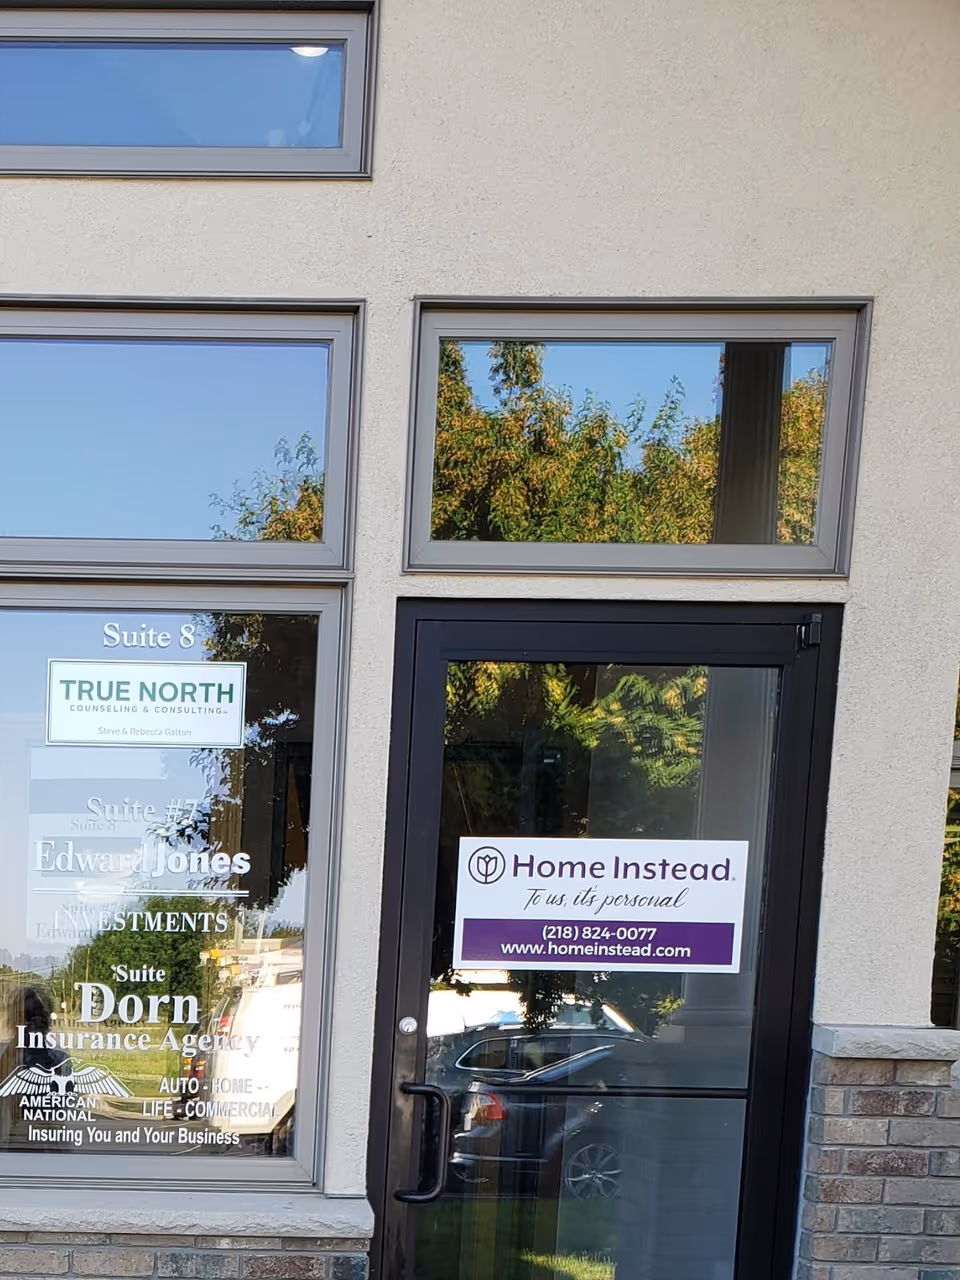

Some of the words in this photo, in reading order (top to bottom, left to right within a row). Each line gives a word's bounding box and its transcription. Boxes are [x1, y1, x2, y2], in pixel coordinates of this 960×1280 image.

[103, 622, 172, 648] Suite
[179, 623, 195, 648] 8
[59, 679, 131, 702] TRUE
[139, 681, 234, 704] NORTH
[69, 704, 138, 714] COUNSELING
[142, 706, 149, 714] &
[97, 726, 121, 736] Steve
[121, 727, 129, 736] &
[129, 726, 163, 737] Rebecca
[87, 797, 156, 823] Suite
[165, 798, 199, 823] #7
[32, 840, 149, 874] Edward
[151, 842, 251, 877] Jones
[512, 854, 606, 880] Home
[523, 888, 547, 911] To
[547, 891, 567, 908] us,
[594, 887, 690, 915] personal
[52, 909, 229, 933] INVESTMENTS
[542, 925, 578, 941] (218)
[581, 926, 657, 941] 824-0077
[500, 941, 691, 958] www.homeinstead.com
[115, 964, 166, 983] Suite
[76, 981, 200, 1025] Dorn
[15, 1025, 151, 1052] Insurance
[160, 1026, 259, 1058] Agency
[159, 1077, 200, 1094] AUTO
[211, 1077, 253, 1095] HOME
[19, 1096, 97, 1109] AMERICAN
[142, 1101, 173, 1118] LIFE
[23, 1108, 97, 1122] NATIONAL
[28, 1125, 83, 1146] Insuring
[87, 1127, 113, 1144] You
[115, 1126, 140, 1144] and
[142, 1127, 175, 1145] Your
[177, 1128, 240, 1145] Business
